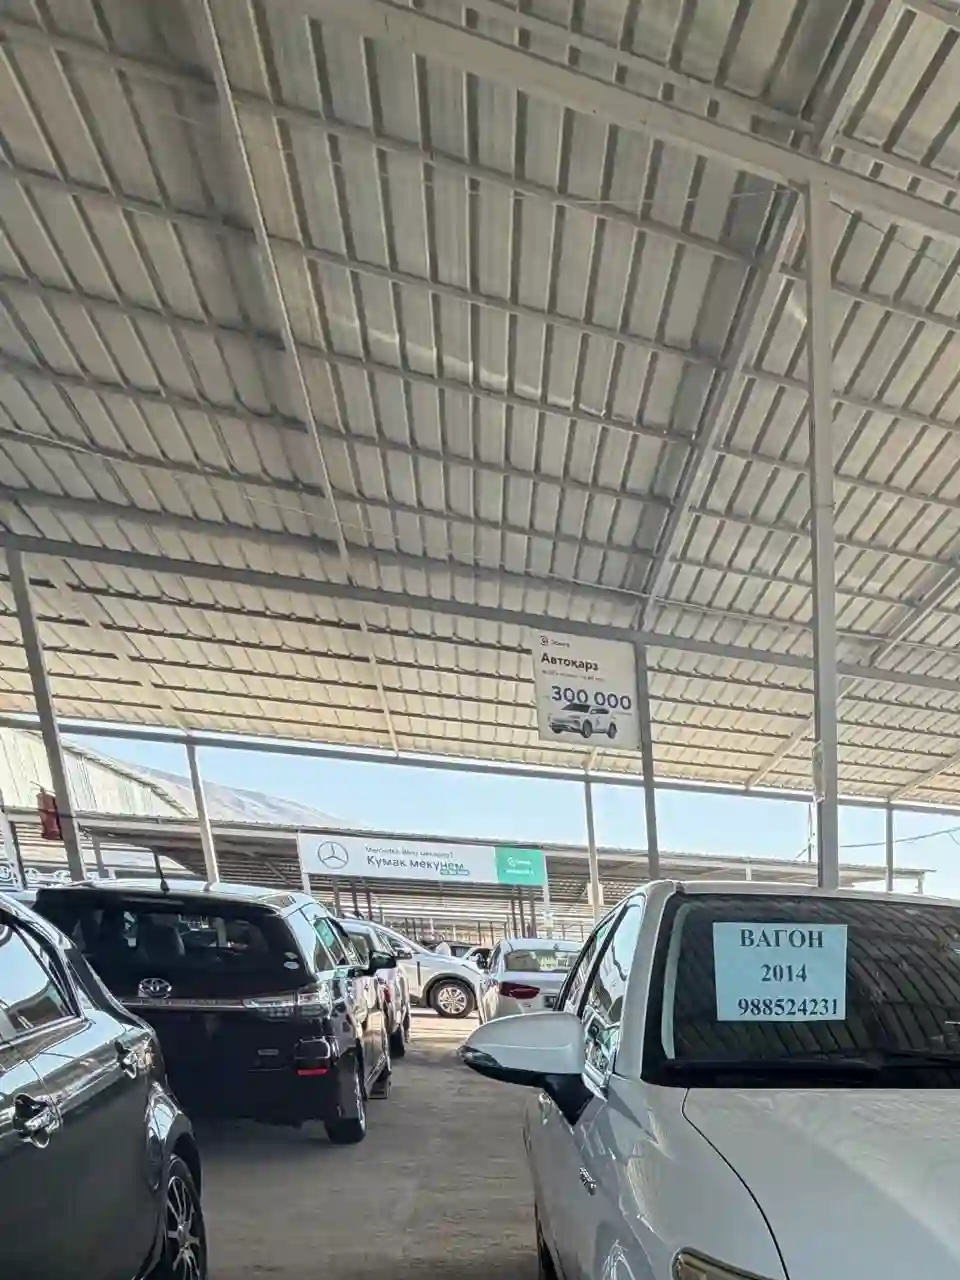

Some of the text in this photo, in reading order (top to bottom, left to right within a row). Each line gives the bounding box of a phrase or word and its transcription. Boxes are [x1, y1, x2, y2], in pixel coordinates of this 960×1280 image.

[551, 685, 632, 710] 300 000
[740, 929, 825, 948] ВАГОН
[760, 963, 808, 982] 2014
[737, 997, 838, 1016] 988524231
